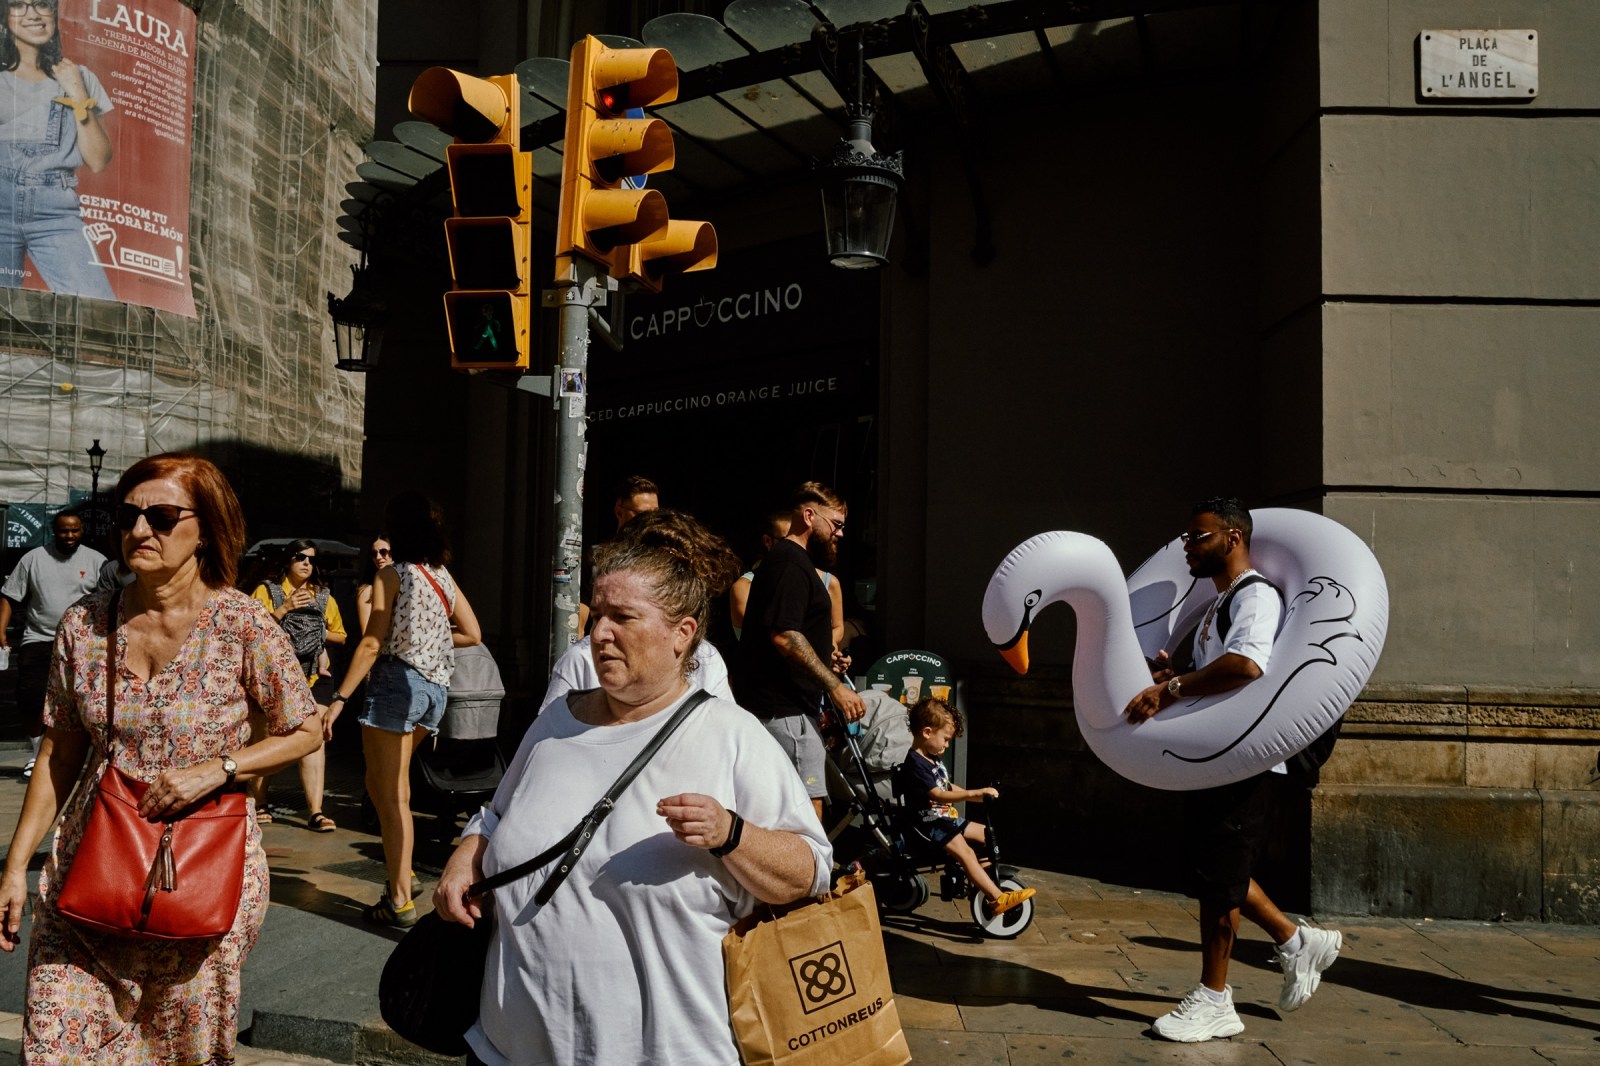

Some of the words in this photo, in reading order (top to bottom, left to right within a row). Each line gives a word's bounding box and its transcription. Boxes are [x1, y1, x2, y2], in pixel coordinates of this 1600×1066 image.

[89, 0, 189, 57] LAURA
[88, 34, 126, 51] CADENA
[127, 45, 139, 55] DE
[140, 49, 168, 66] MENJAR
[104, 28, 166, 58] TREBALLADORA
[1459, 38, 1498, 51] PLAÇA
[135, 60, 151, 71] Amb
[151, 66, 157, 74] la
[1472, 55, 1487, 66] DE
[110, 70, 145, 85] dissenyar
[132, 68, 152, 80] Laura
[112, 88, 149, 105] Catalunya.
[124, 109, 137, 118] ara
[133, 103, 143, 111] de
[79, 194, 121, 211] GENT
[122, 203, 151, 220] COM
[152, 211, 168, 225] TU
[79, 206, 143, 230] MILLORA
[143, 221, 159, 235] EL
[160, 226, 184, 243] MÓN
[123, 251, 160, 269] CCOO
[589, 408, 613, 423] CED
[618, 395, 711, 419] CAPPUCCINO
[715, 385, 781, 405] ORANGE
[788, 377, 837, 397] JUICE
[788, 997, 883, 1051] COTTONREUS
